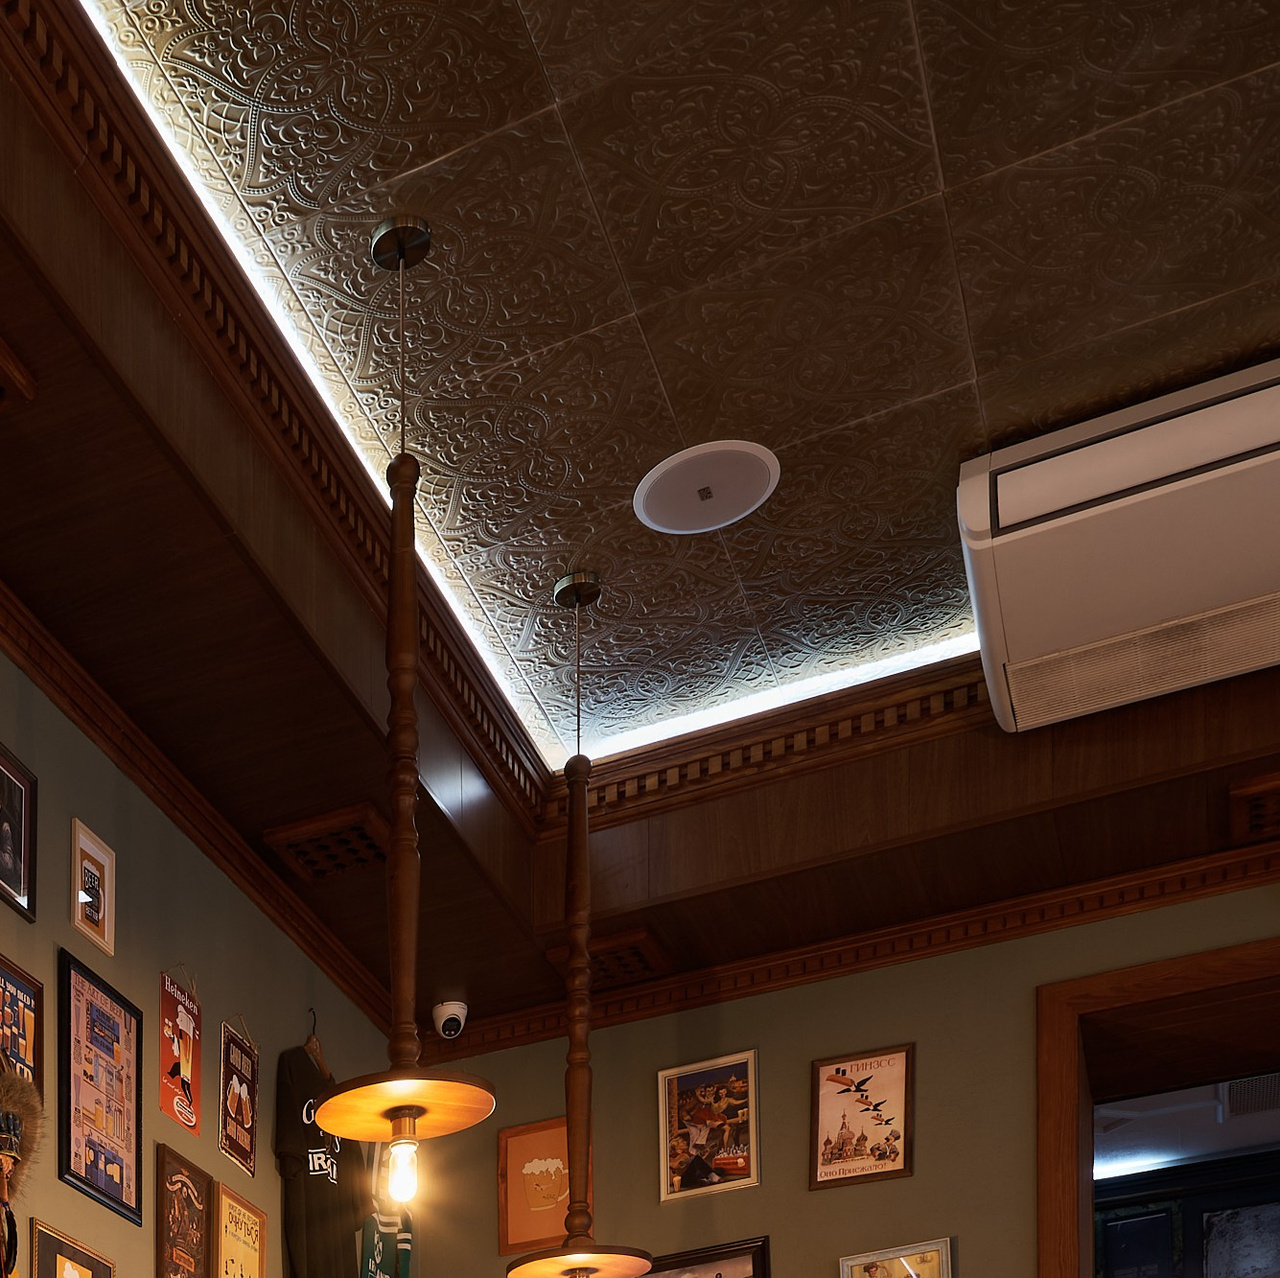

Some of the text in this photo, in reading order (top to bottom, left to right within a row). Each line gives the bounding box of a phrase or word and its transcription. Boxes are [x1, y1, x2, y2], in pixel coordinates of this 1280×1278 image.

[84, 869, 99, 890] BEER
[74, 972, 86, 992] THE
[87, 983, 99, 1001] ART
[100, 994, 109, 1006] OF
[109, 1000, 124, 1020] BEER
[164, 975, 199, 1016] Heineken
[228, 1211, 259, 1245] ОЧНУТЬСЯ
